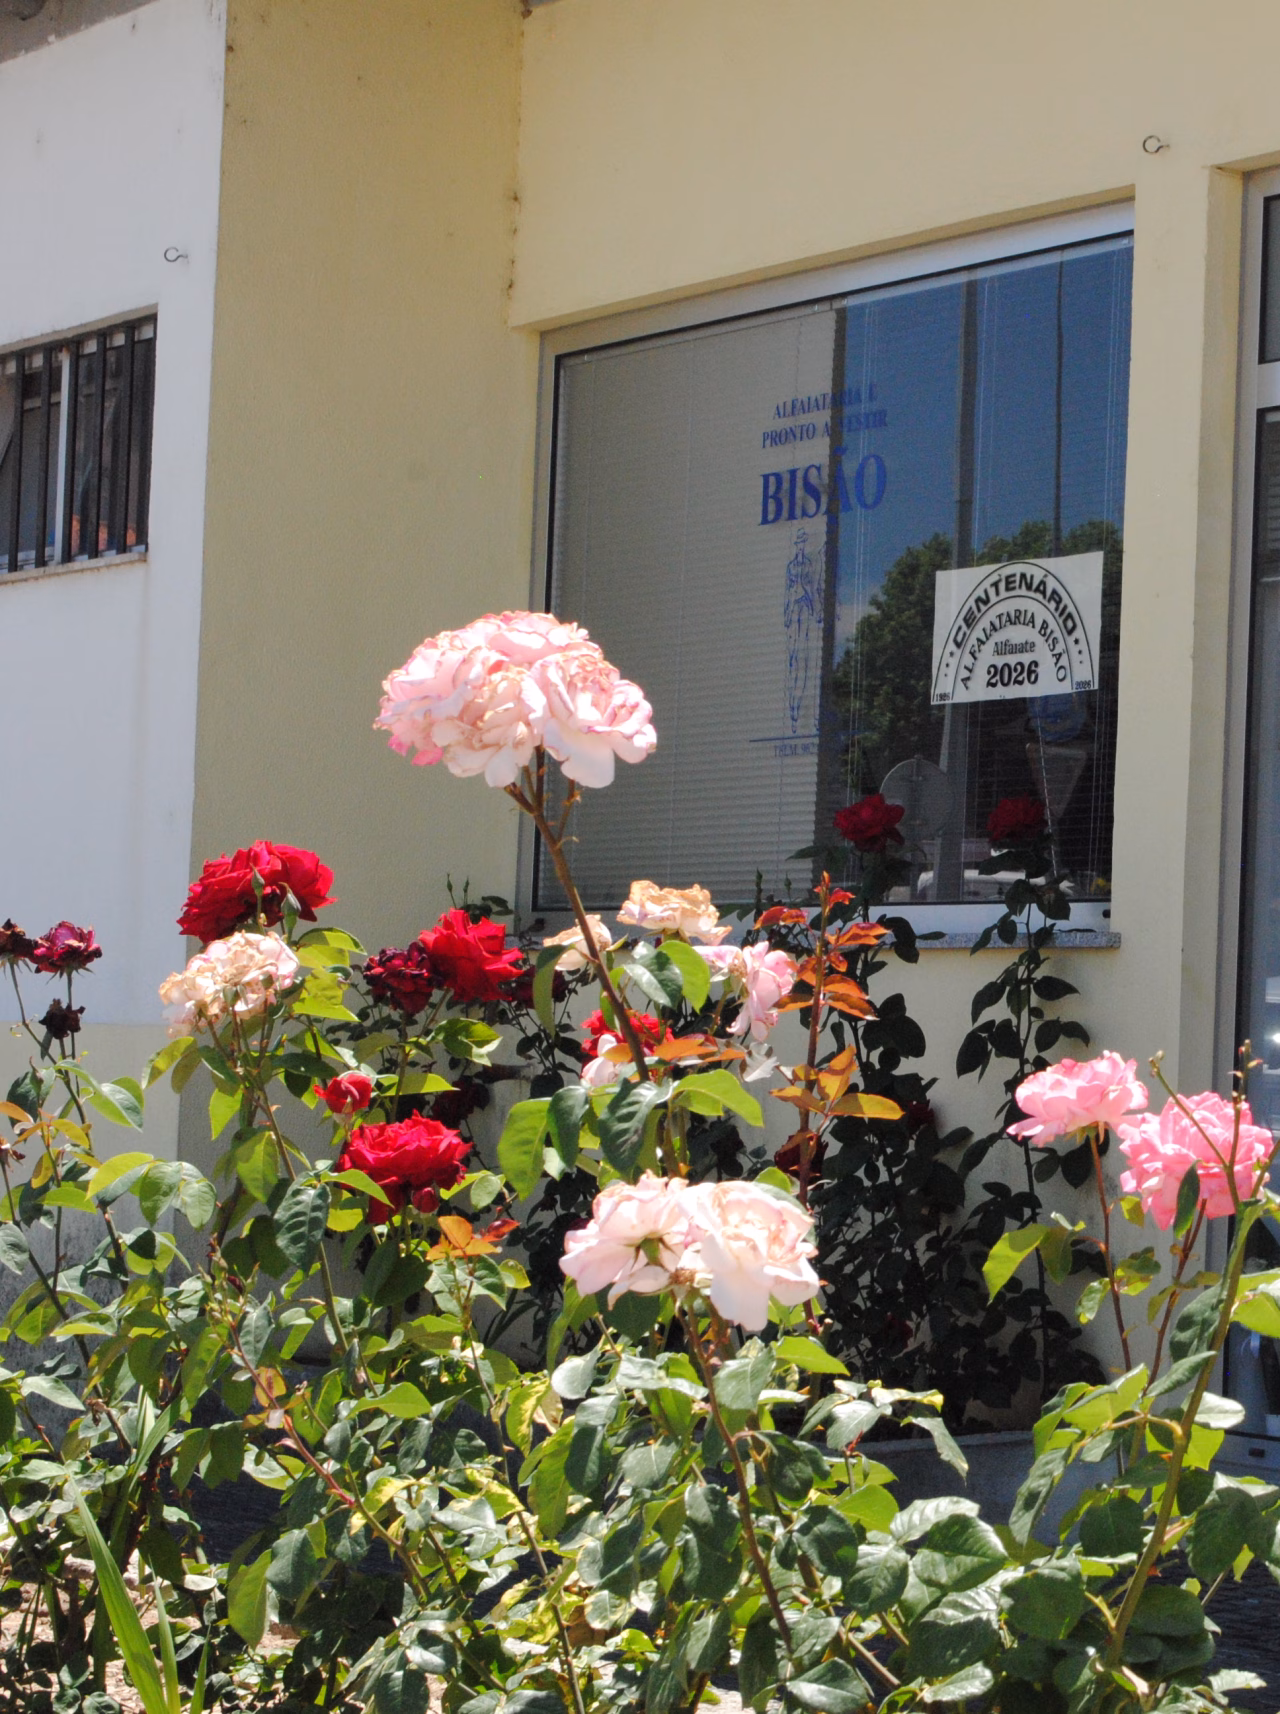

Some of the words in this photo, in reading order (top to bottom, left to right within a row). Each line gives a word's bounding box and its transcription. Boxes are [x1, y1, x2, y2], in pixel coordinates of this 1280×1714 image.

[762, 422, 816, 448] PRONTO
[821, 420, 832, 438] A
[758, 446, 887, 526] BISÃO
[952, 572, 1077, 650] CENTENÁRIO
[960, 609, 1036, 690] ALFAIATARIA
[1038, 619, 1067, 682] BISÃO
[992, 638, 1035, 656] Alfaiate
[986, 660, 1039, 688] 2026
